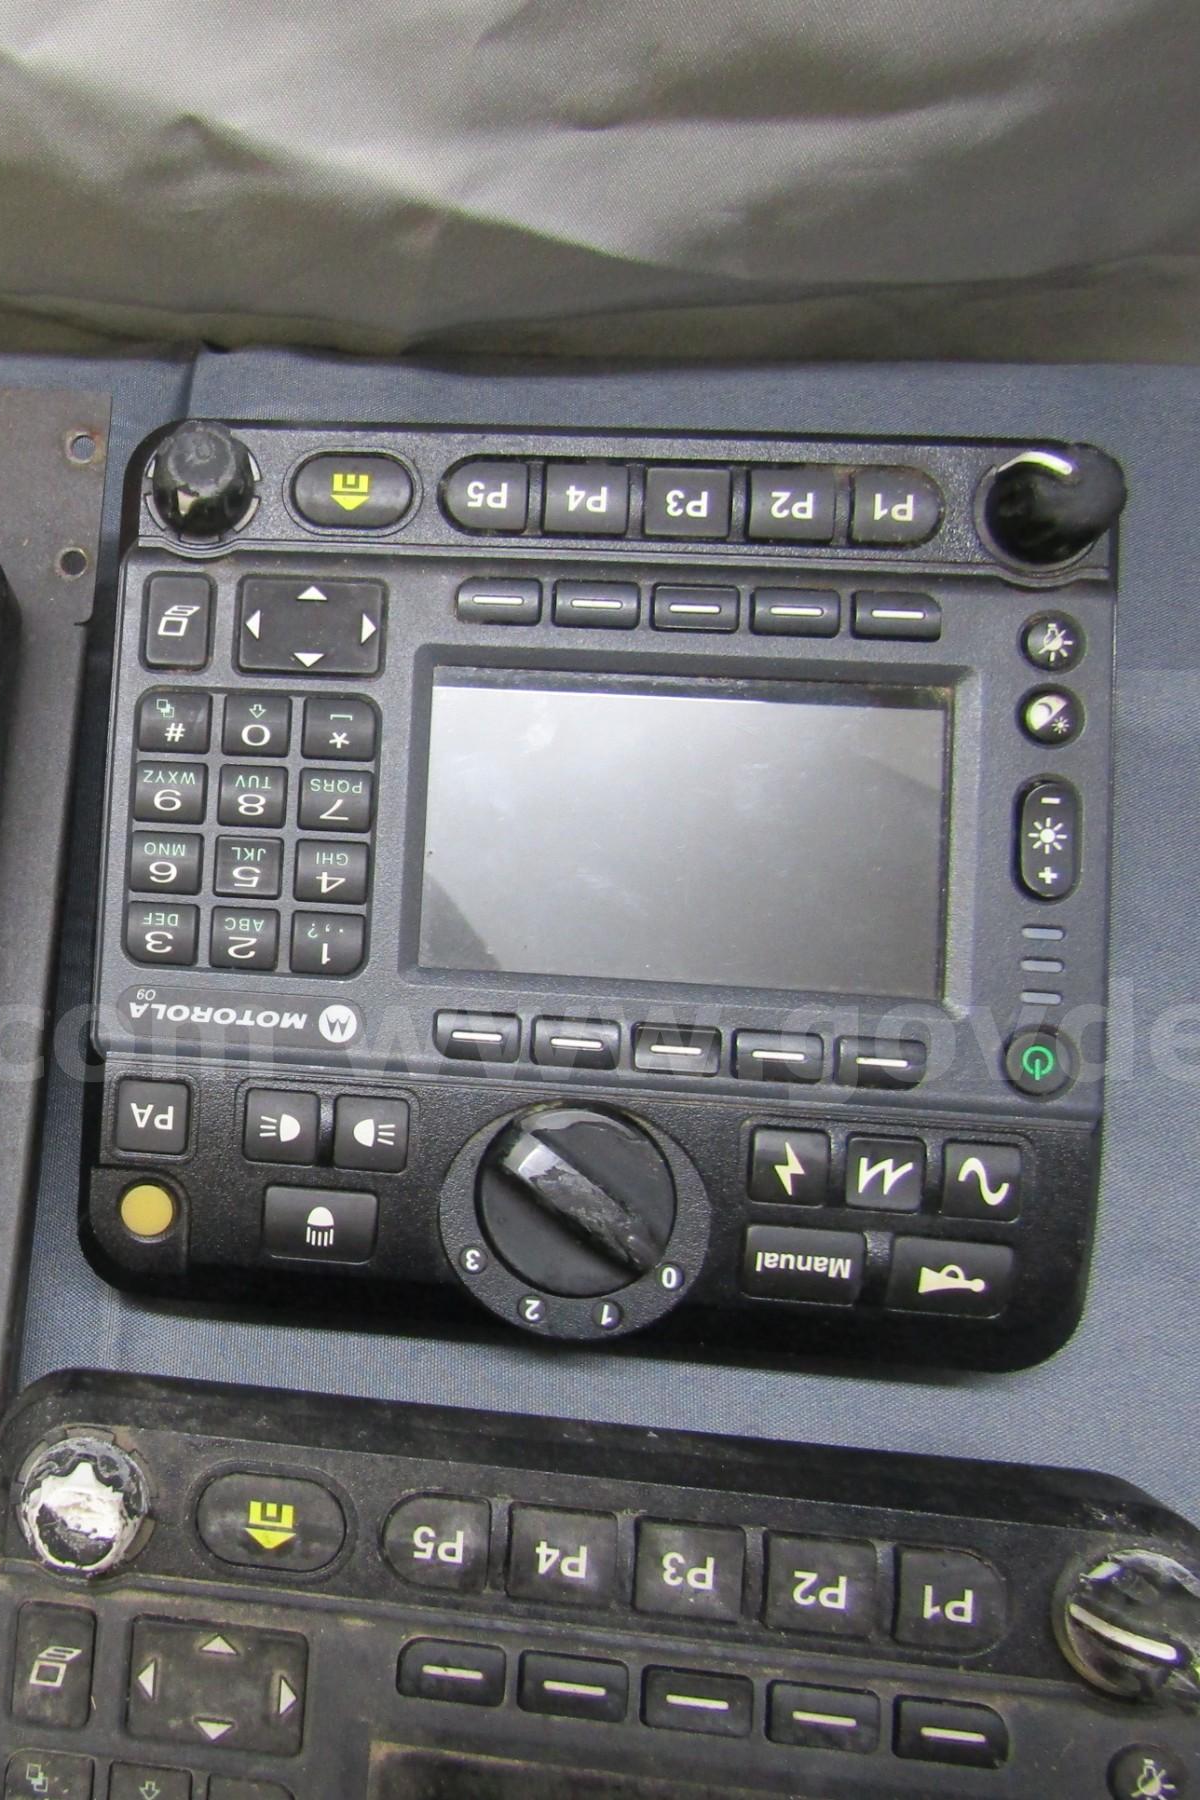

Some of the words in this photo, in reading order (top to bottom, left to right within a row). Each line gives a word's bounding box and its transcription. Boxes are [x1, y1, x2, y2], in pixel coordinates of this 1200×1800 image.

[467, 481, 508, 508] P5
[566, 486, 608, 512] P4
[666, 490, 708, 517] P3
[771, 491, 814, 518] P2
[874, 494, 914, 521] P1
[165, 723, 185, 741] #
[143, 770, 195, 784] WXYZ
[235, 775, 271, 789] TUV
[311, 779, 362, 793] PQRS
[154, 789, 181, 810] 9
[238, 794, 266, 815] 8
[320, 799, 348, 820] 7
[144, 842, 185, 856] MNO
[232, 847, 266, 861] JKL
[316, 853, 348, 865] GHI
[150, 861, 177, 882] 6
[233, 867, 260, 887] 5
[316, 872, 346, 893] 4
[143, 913, 178, 926] DEF
[225, 918, 264, 932] ABC
[145, 931, 173, 952] 3
[228, 936, 257, 958] 2
[322, 943, 330, 964] 1
[130, 1003, 307, 1029] MOTOROLA
[131, 1103, 173, 1130] PA
[466, 1250, 480, 1270] 3
[756, 1252, 851, 1278] Manual
[662, 1267, 677, 1288] 0
[526, 1300, 540, 1320] 2
[601, 1305, 612, 1325] 1
[414, 1527, 465, 1563] P5
[536, 1541, 587, 1580] P4
[663, 1552, 714, 1590] P3
[793, 1571, 846, 1610] P2
[924, 1585, 973, 1623] P1
